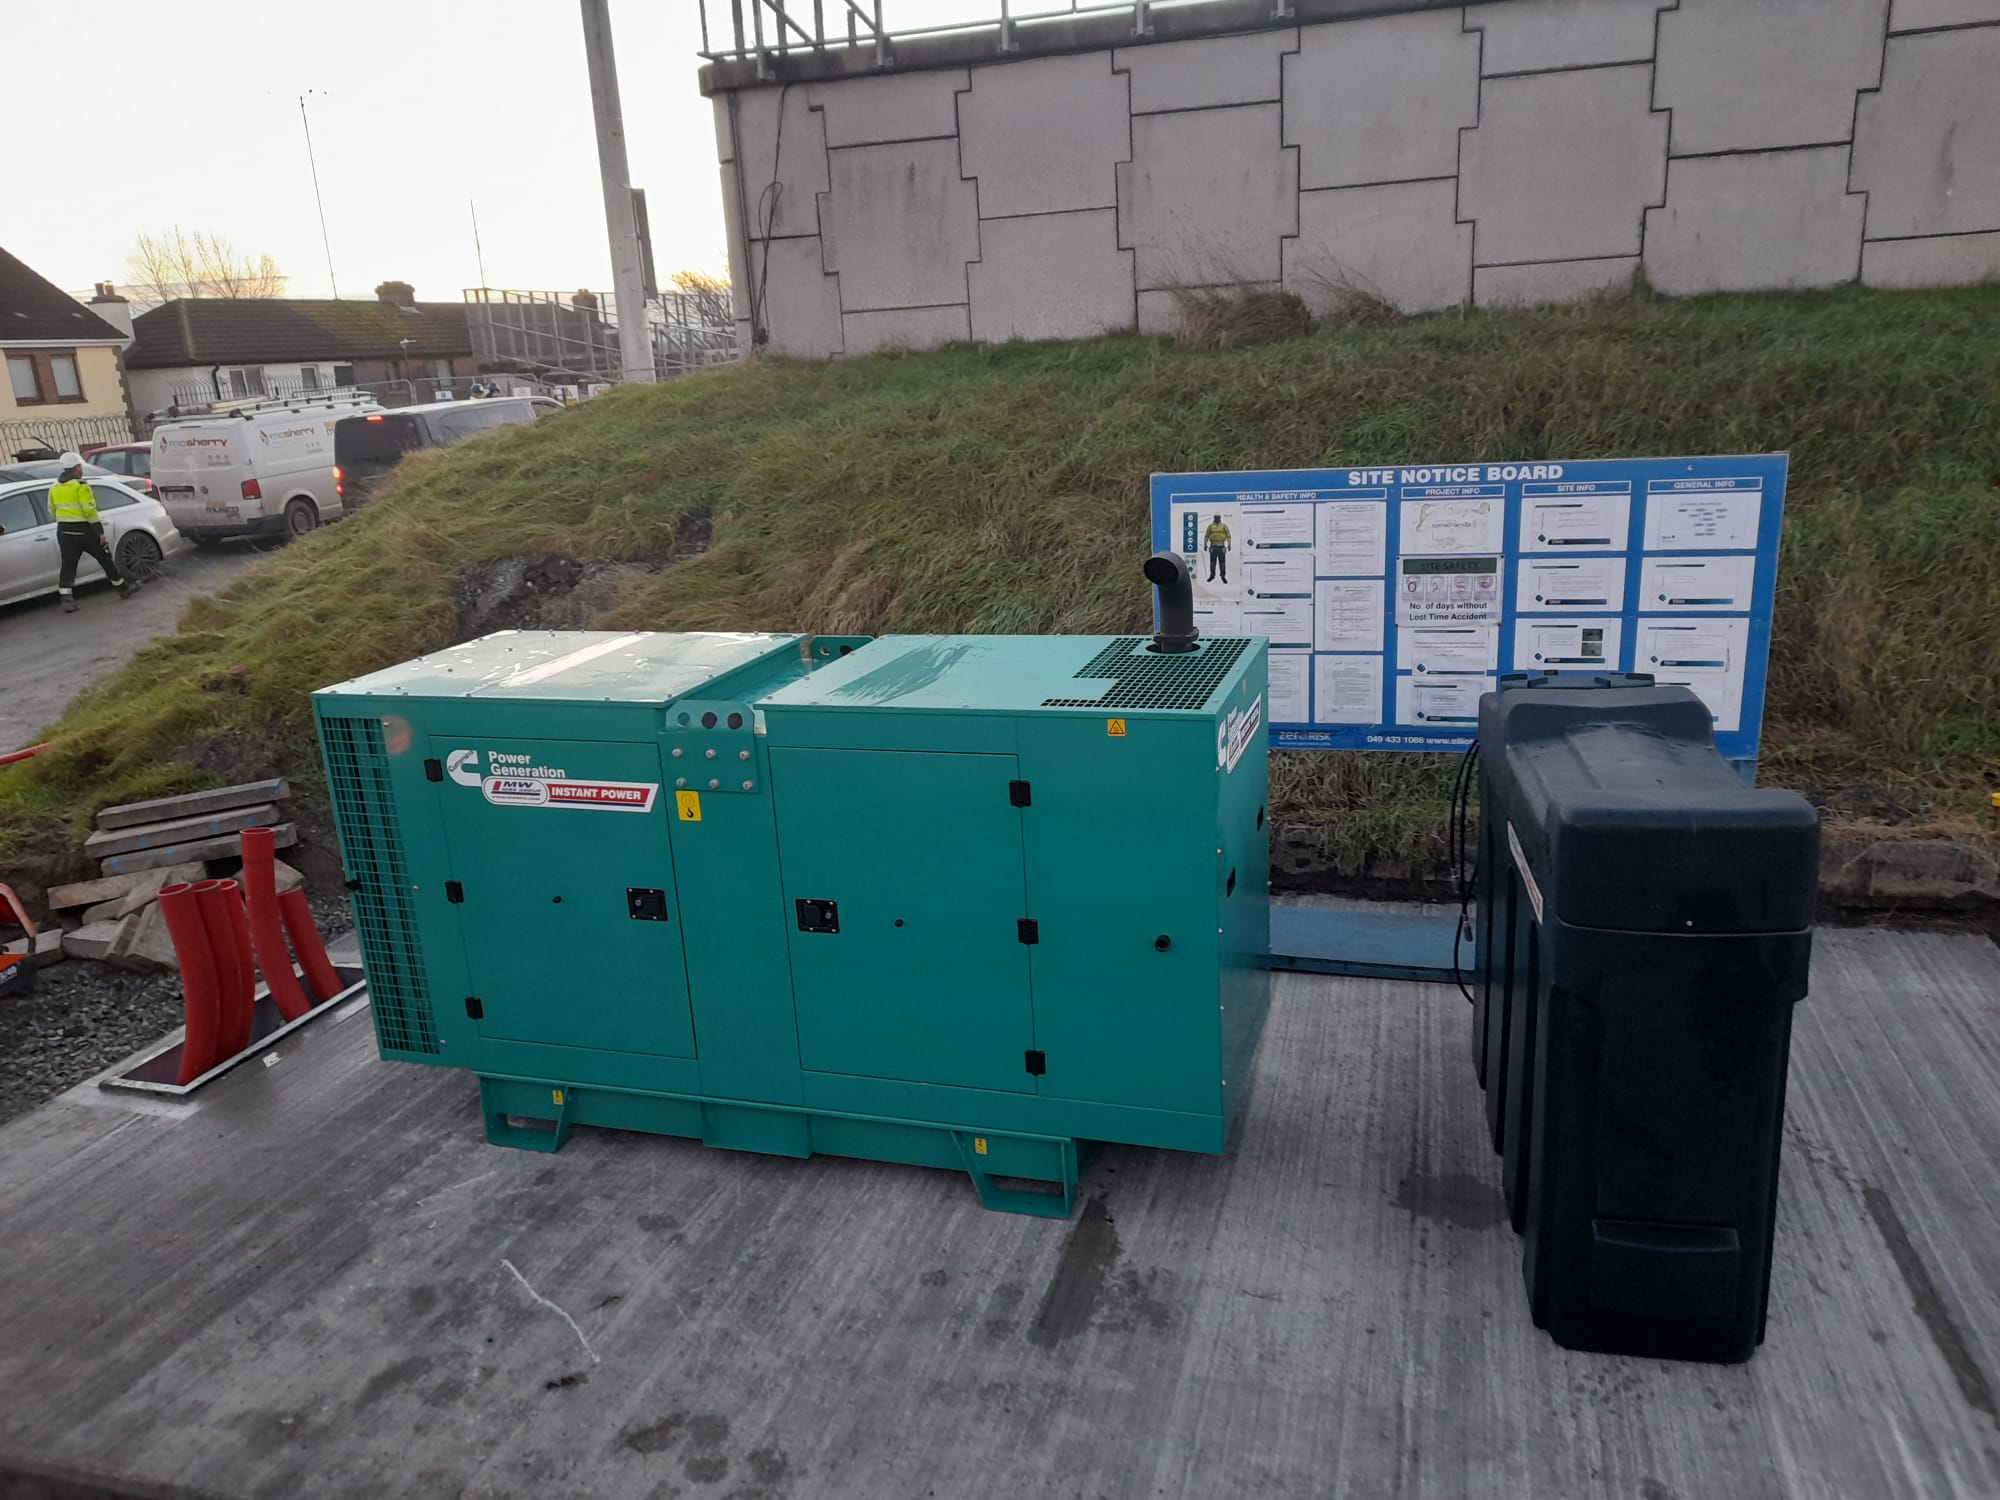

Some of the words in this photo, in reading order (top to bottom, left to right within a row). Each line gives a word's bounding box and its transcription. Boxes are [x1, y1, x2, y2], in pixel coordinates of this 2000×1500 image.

[269, 426, 315, 441] mcsherry
[168, 437, 228, 448] mcsherry
[1348, 470, 1395, 486] SITE
[1401, 466, 1481, 484] NOTICE
[1487, 465, 1564, 482] BOARD
[1557, 485, 1576, 493] SITE
[1577, 484, 1596, 492] INFO
[1673, 480, 1713, 489] GENERAL
[1715, 480, 1735, 488] INFO
[1236, 493, 1263, 501] HEALTH
[1271, 492, 1298, 500] SAFETY
[1299, 492, 1317, 500] INFO
[1425, 488, 1459, 496] PROJECT
[1460, 487, 1481, 495] INFO
[1436, 602, 1455, 611] days
[1456, 602, 1487, 610] without
[1409, 613, 1427, 621] Lost
[1429, 612, 1449, 621] Time
[1451, 612, 1487, 620] Accident
[488, 750, 531, 765] Power
[490, 763, 566, 779] Generation
[551, 786, 598, 798] INSTANT
[601, 788, 641, 800] POWER
